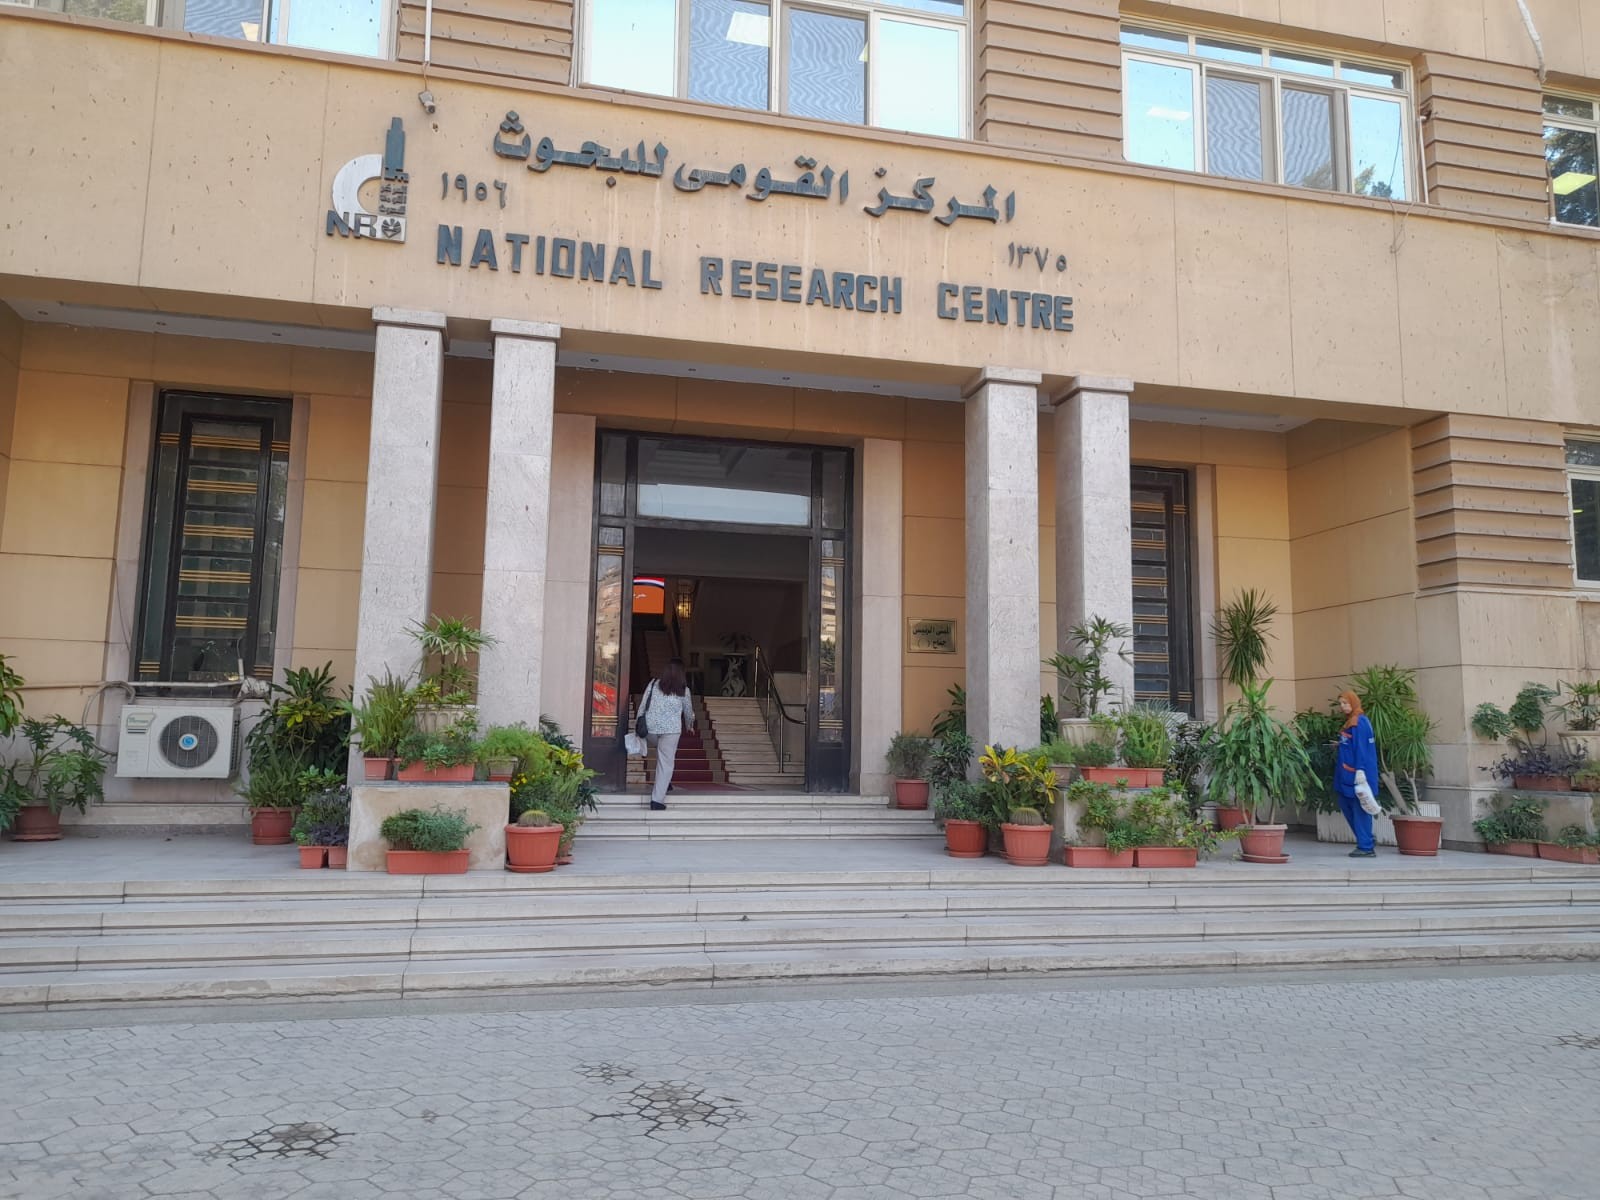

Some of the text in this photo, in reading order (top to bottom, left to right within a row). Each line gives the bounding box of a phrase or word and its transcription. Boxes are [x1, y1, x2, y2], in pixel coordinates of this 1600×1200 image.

[492, 110, 670, 188] للبحوث
[441, 171, 508, 209] ١٩٥٦
[863, 167, 1016, 226] المركز
[436, 223, 1074, 332] NATIONAL RESEARCH CENTRE
[1007, 241, 1068, 272] ١٣٧٥
